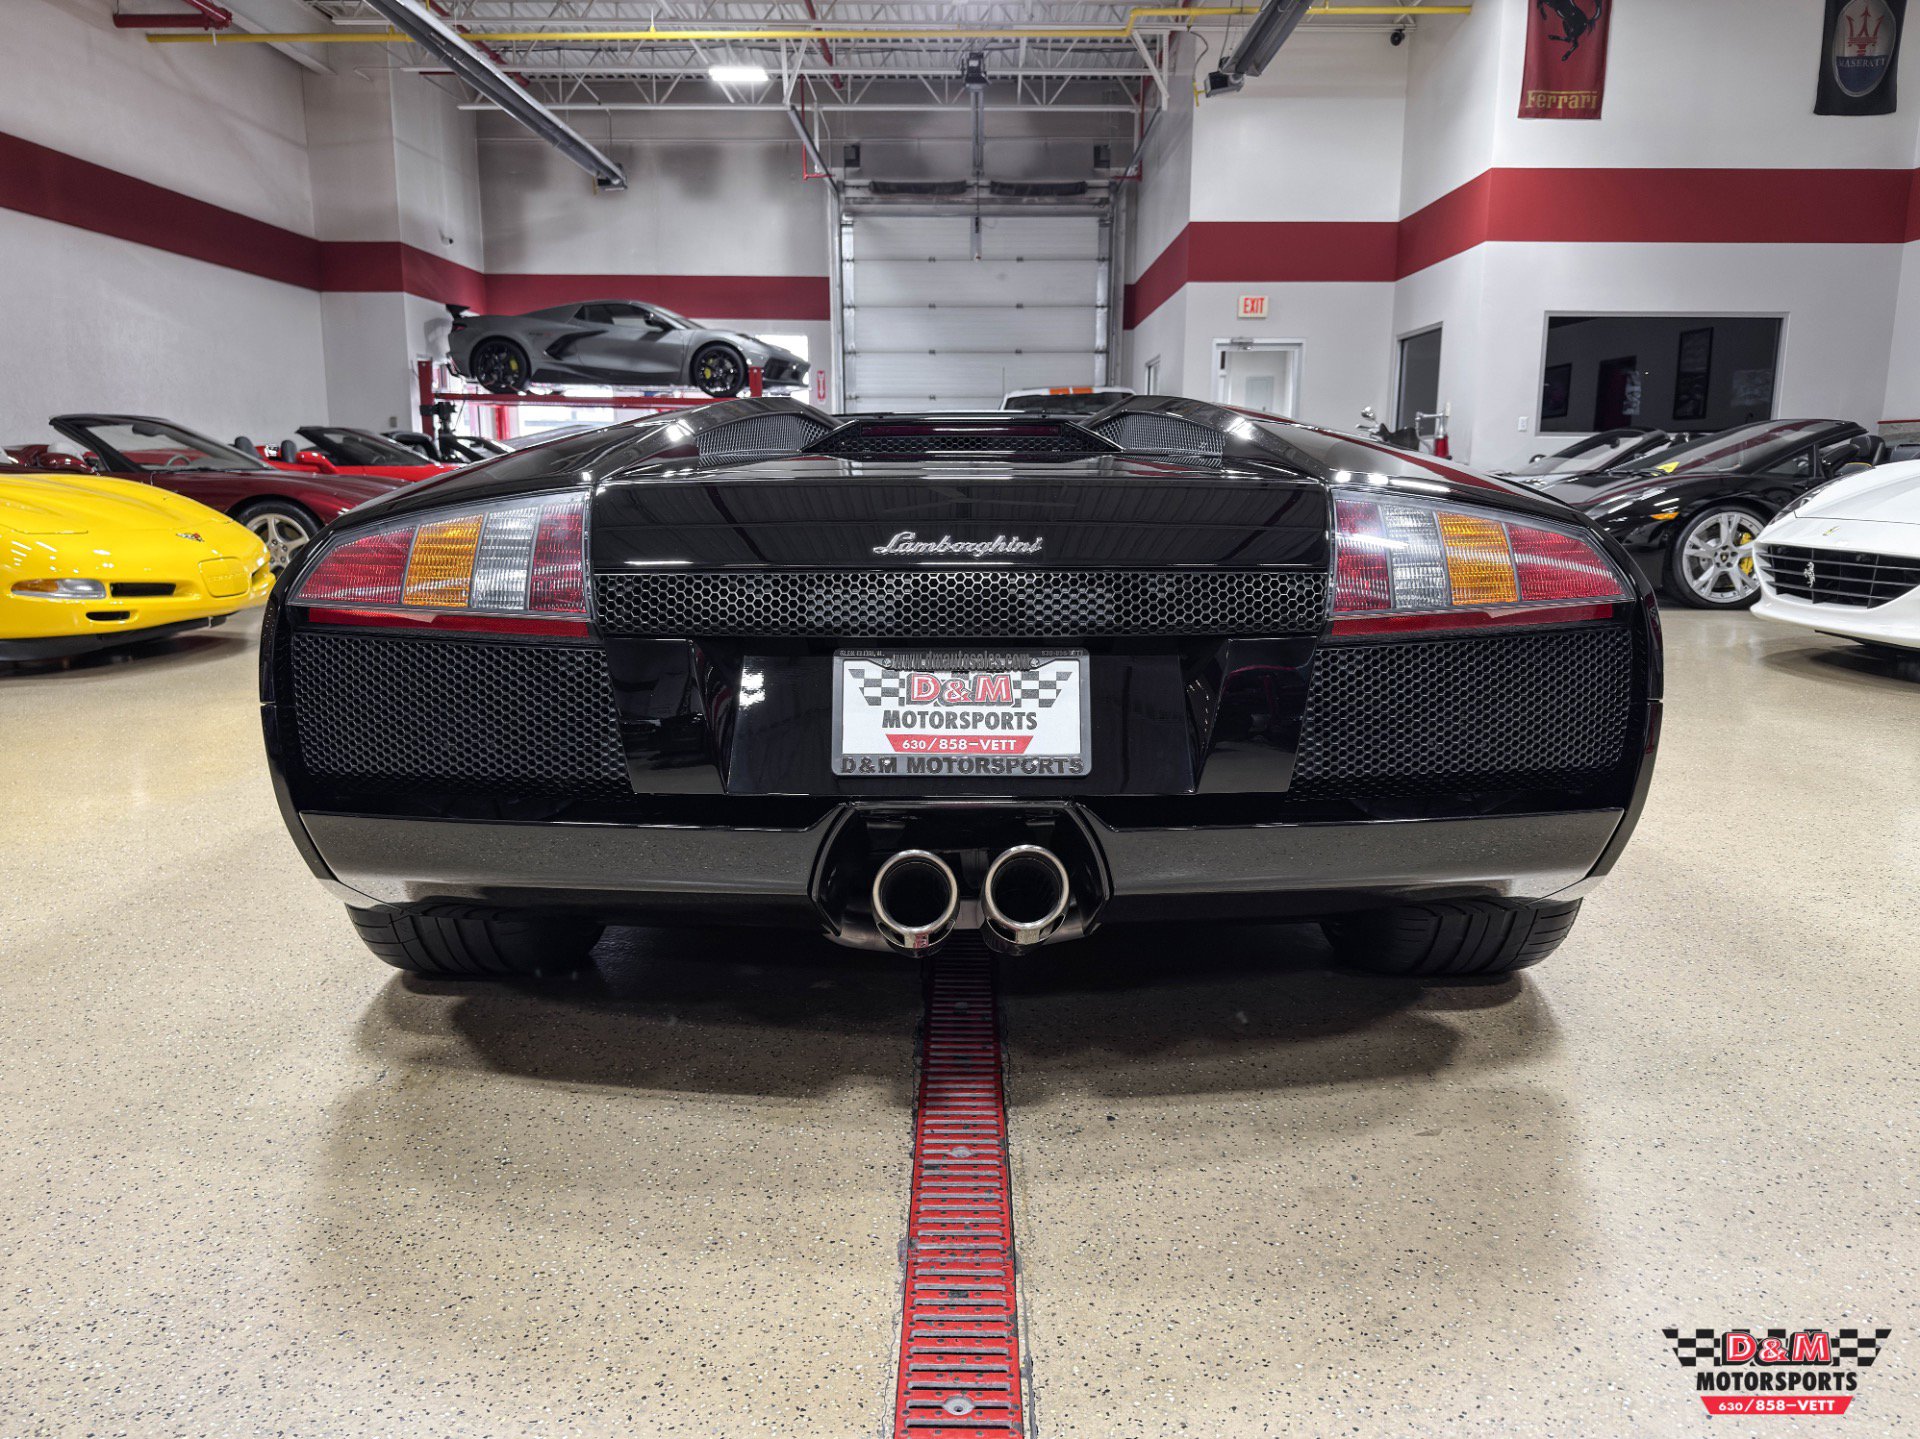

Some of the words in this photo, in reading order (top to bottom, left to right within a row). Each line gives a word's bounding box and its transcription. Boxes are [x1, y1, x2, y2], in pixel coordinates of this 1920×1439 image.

[1525, 90, 1598, 109] Ferrari
[1243, 297, 1265, 314] EXIT
[873, 531, 1044, 559] Lamborghini
[907, 672, 1014, 705] D&M
[882, 710, 1038, 731] MOTORSPORTS
[841, 756, 898, 774] D&M
[906, 756, 1084, 775] MOTORSPORTS
